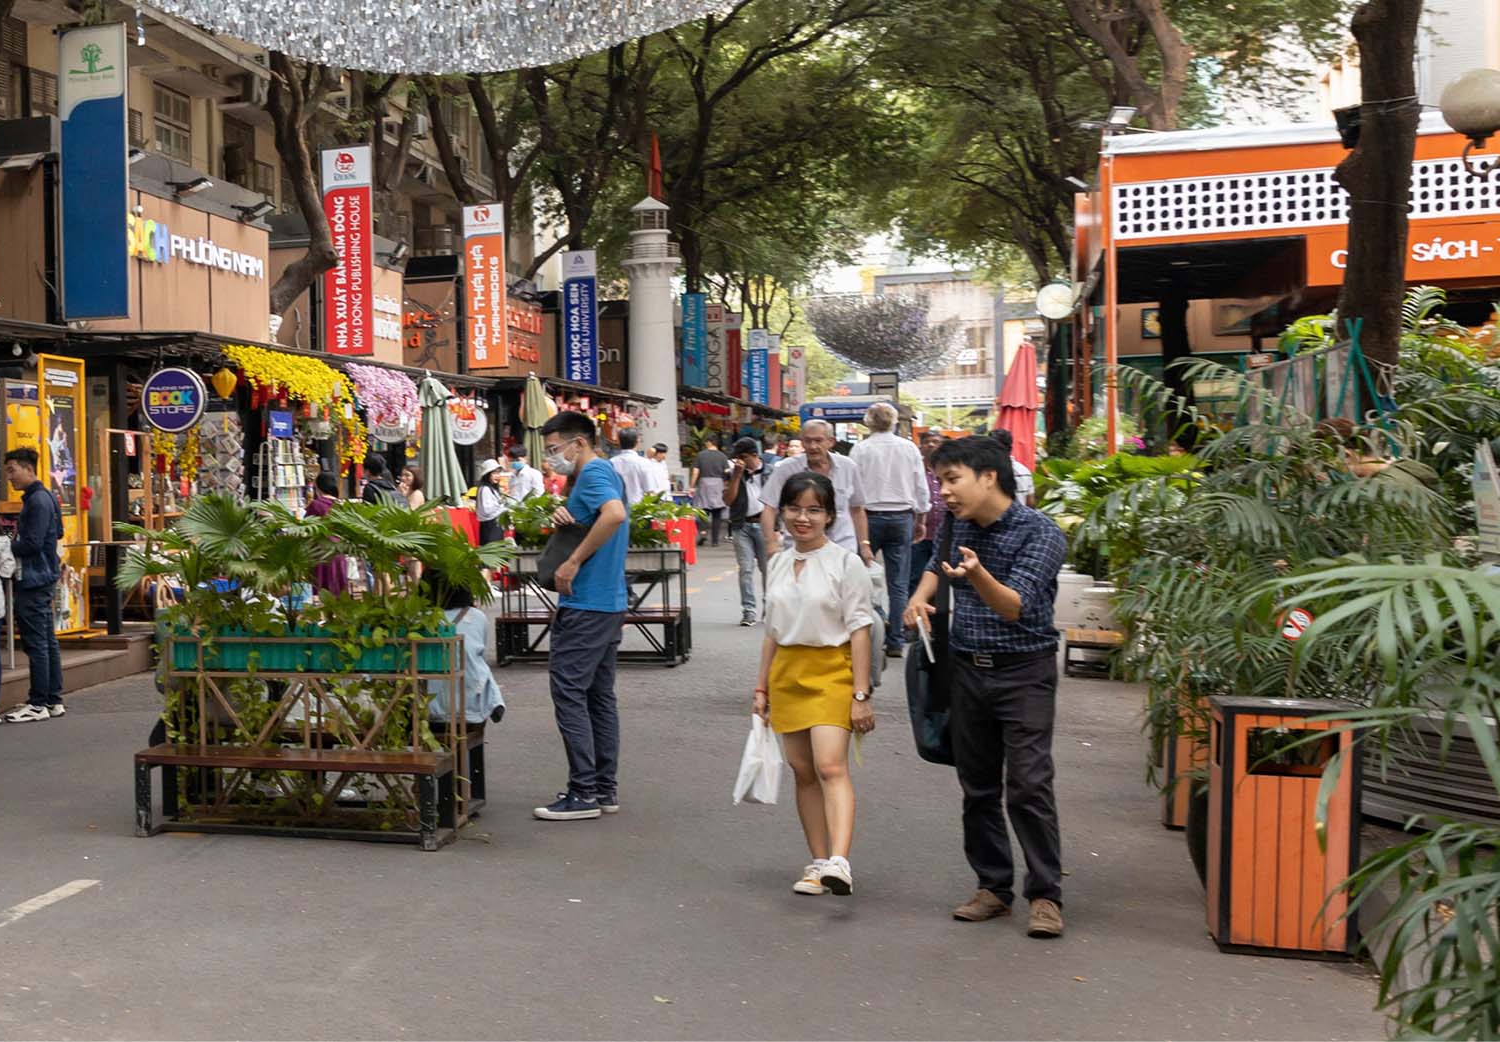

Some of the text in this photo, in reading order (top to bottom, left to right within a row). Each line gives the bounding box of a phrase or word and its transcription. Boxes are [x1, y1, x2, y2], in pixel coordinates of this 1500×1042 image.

[331, 196, 346, 233] ĐỒNG
[469, 244, 484, 270] HÀ
[1411, 237, 1478, 262] SÁCH
[232, 251, 263, 279] NAM
[349, 194, 363, 348] KIM DONG PUBLISHING HOUSE
[333, 287, 348, 320] XUẤT
[471, 272, 485, 311] THÁI
[569, 283, 579, 305] SEN
[570, 307, 580, 331] HOA
[580, 283, 590, 338] UNIVERSITY
[684, 296, 696, 324] News
[335, 322, 348, 349] NHÀ
[472, 314, 488, 360] SÁCH
[149, 390, 193, 406] BOOK
[150, 405, 195, 414] STORE
